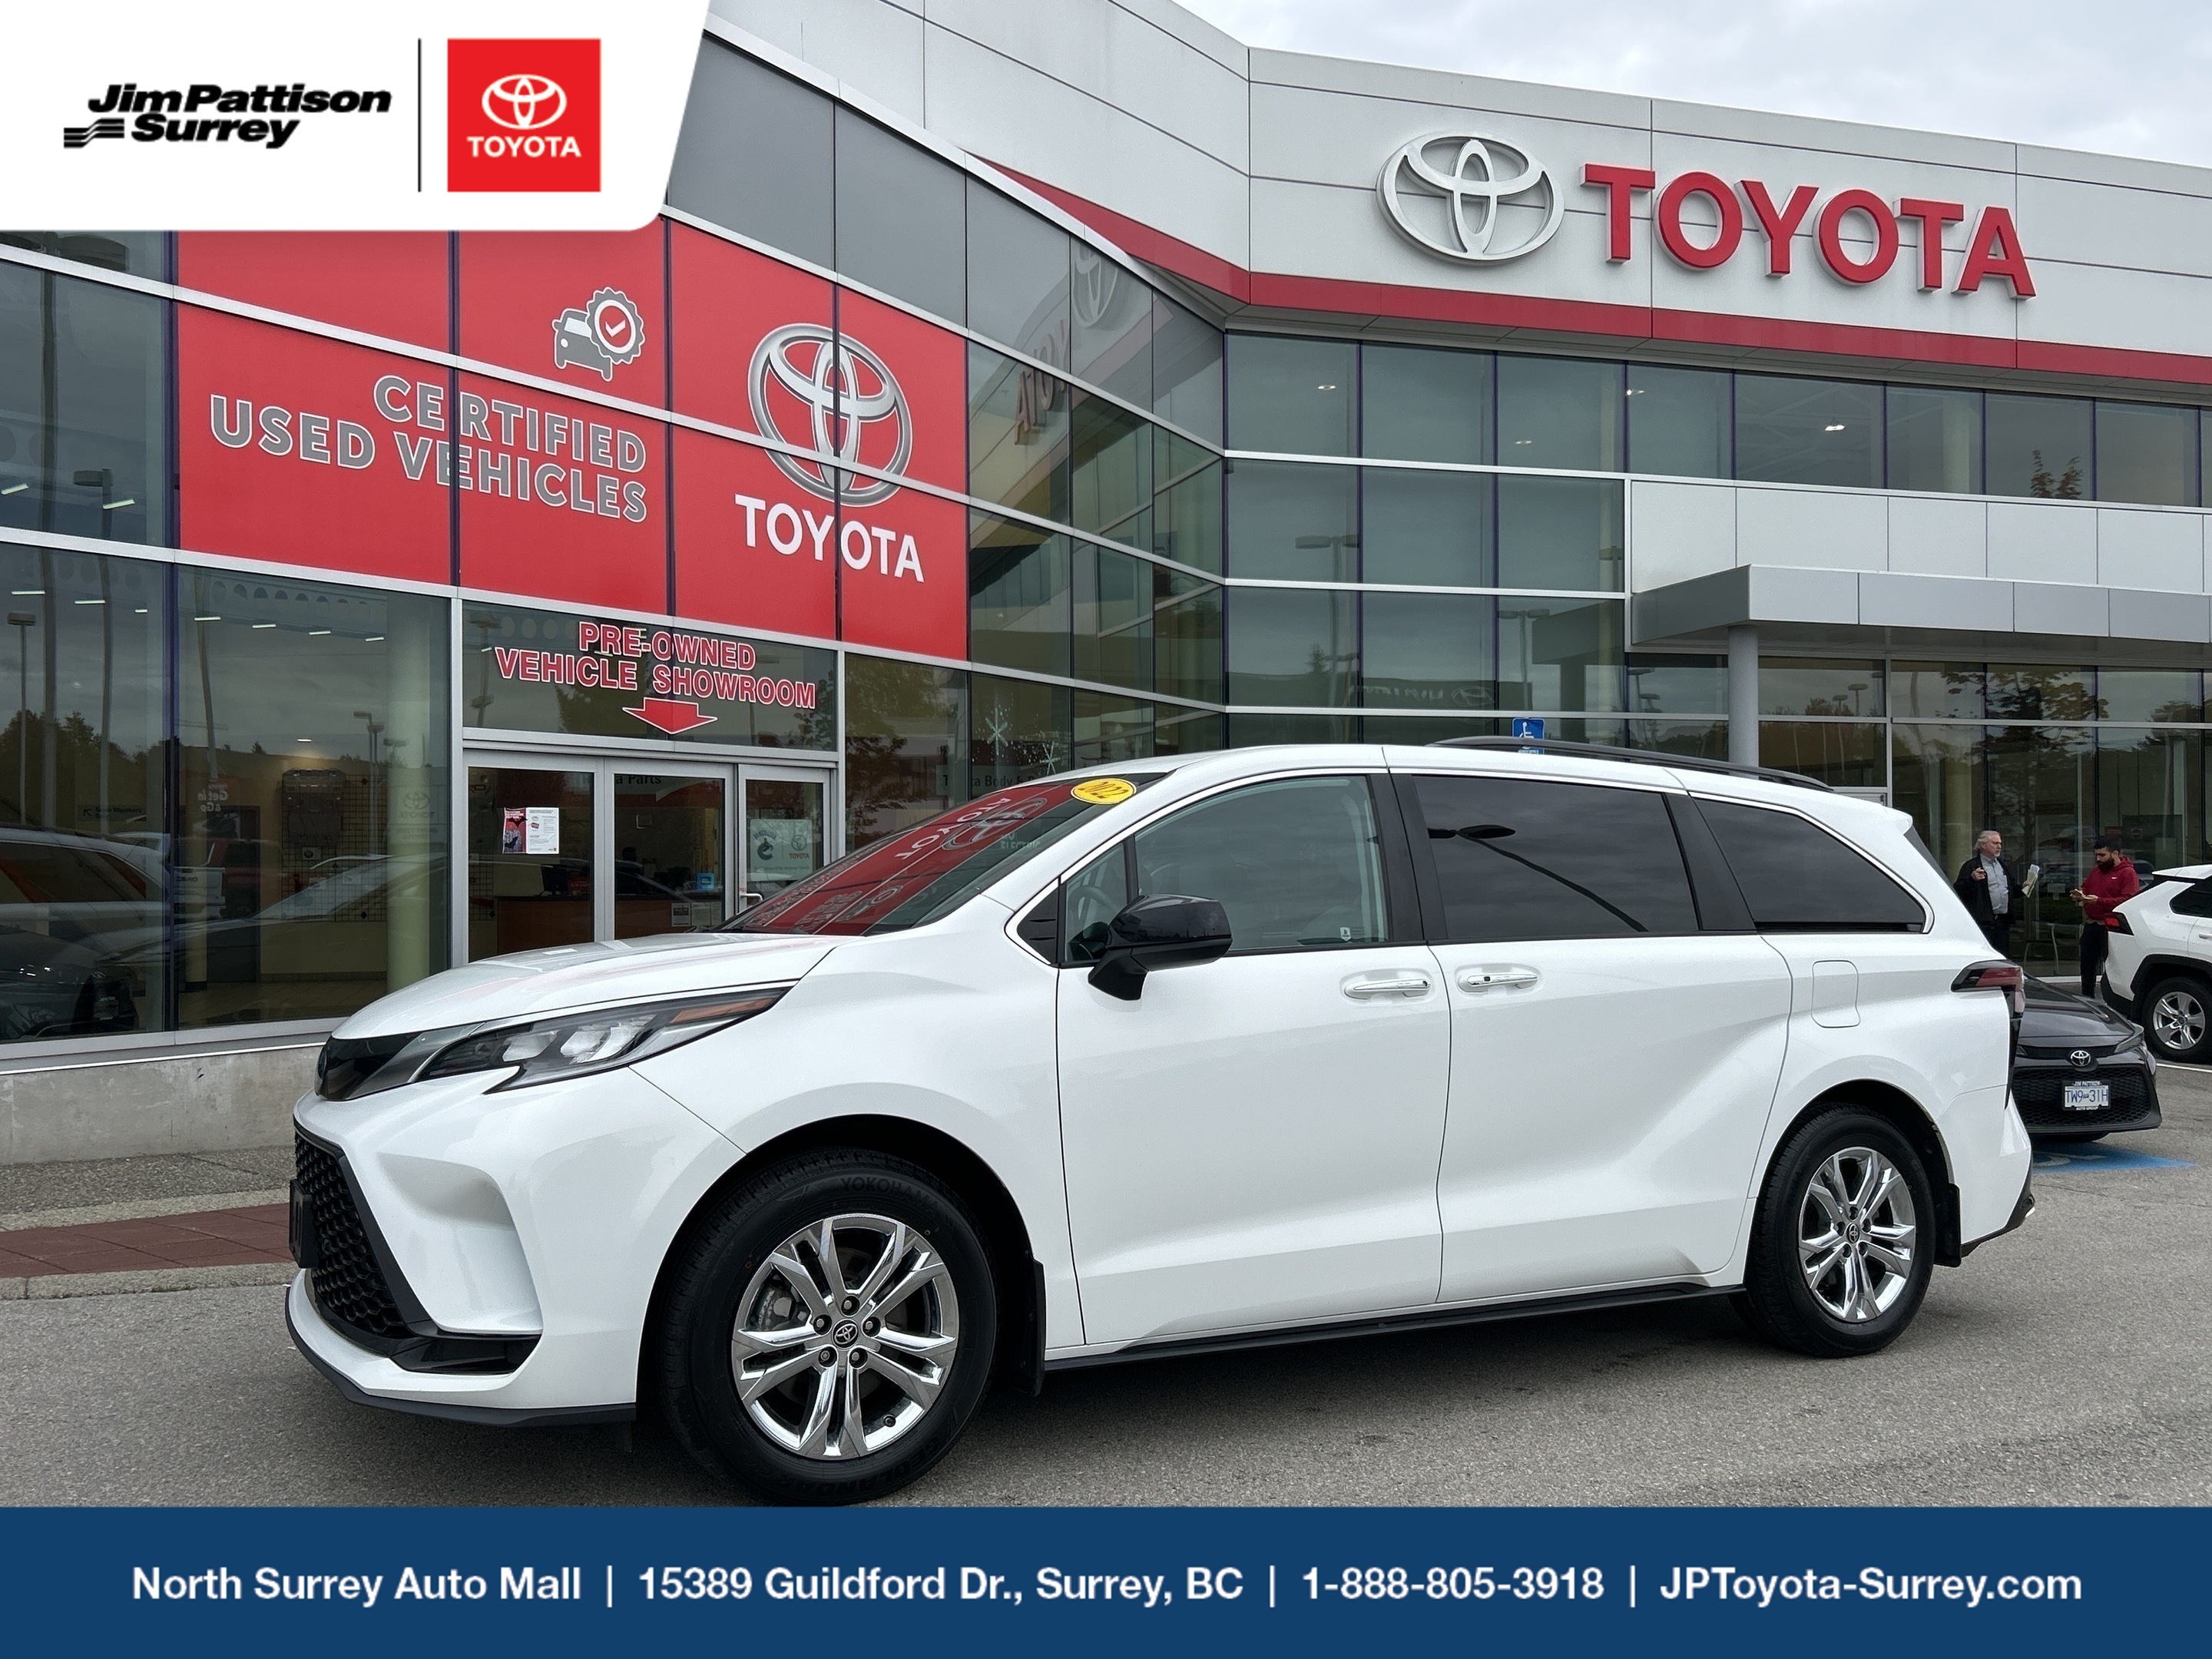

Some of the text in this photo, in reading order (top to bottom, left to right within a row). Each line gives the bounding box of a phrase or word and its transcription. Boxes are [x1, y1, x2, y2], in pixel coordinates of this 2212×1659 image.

[1580, 163, 2036, 300] TOYOTA
[210, 393, 647, 522] USED VEHICLES
[373, 375, 646, 473] CERTIFIED
[734, 493, 925, 583] TOYOTA
[494, 647, 816, 709] VEHICLE SHOWROOM
[579, 621, 757, 671] PRE-OWNED
[1077, 781, 1129, 800] 2022
